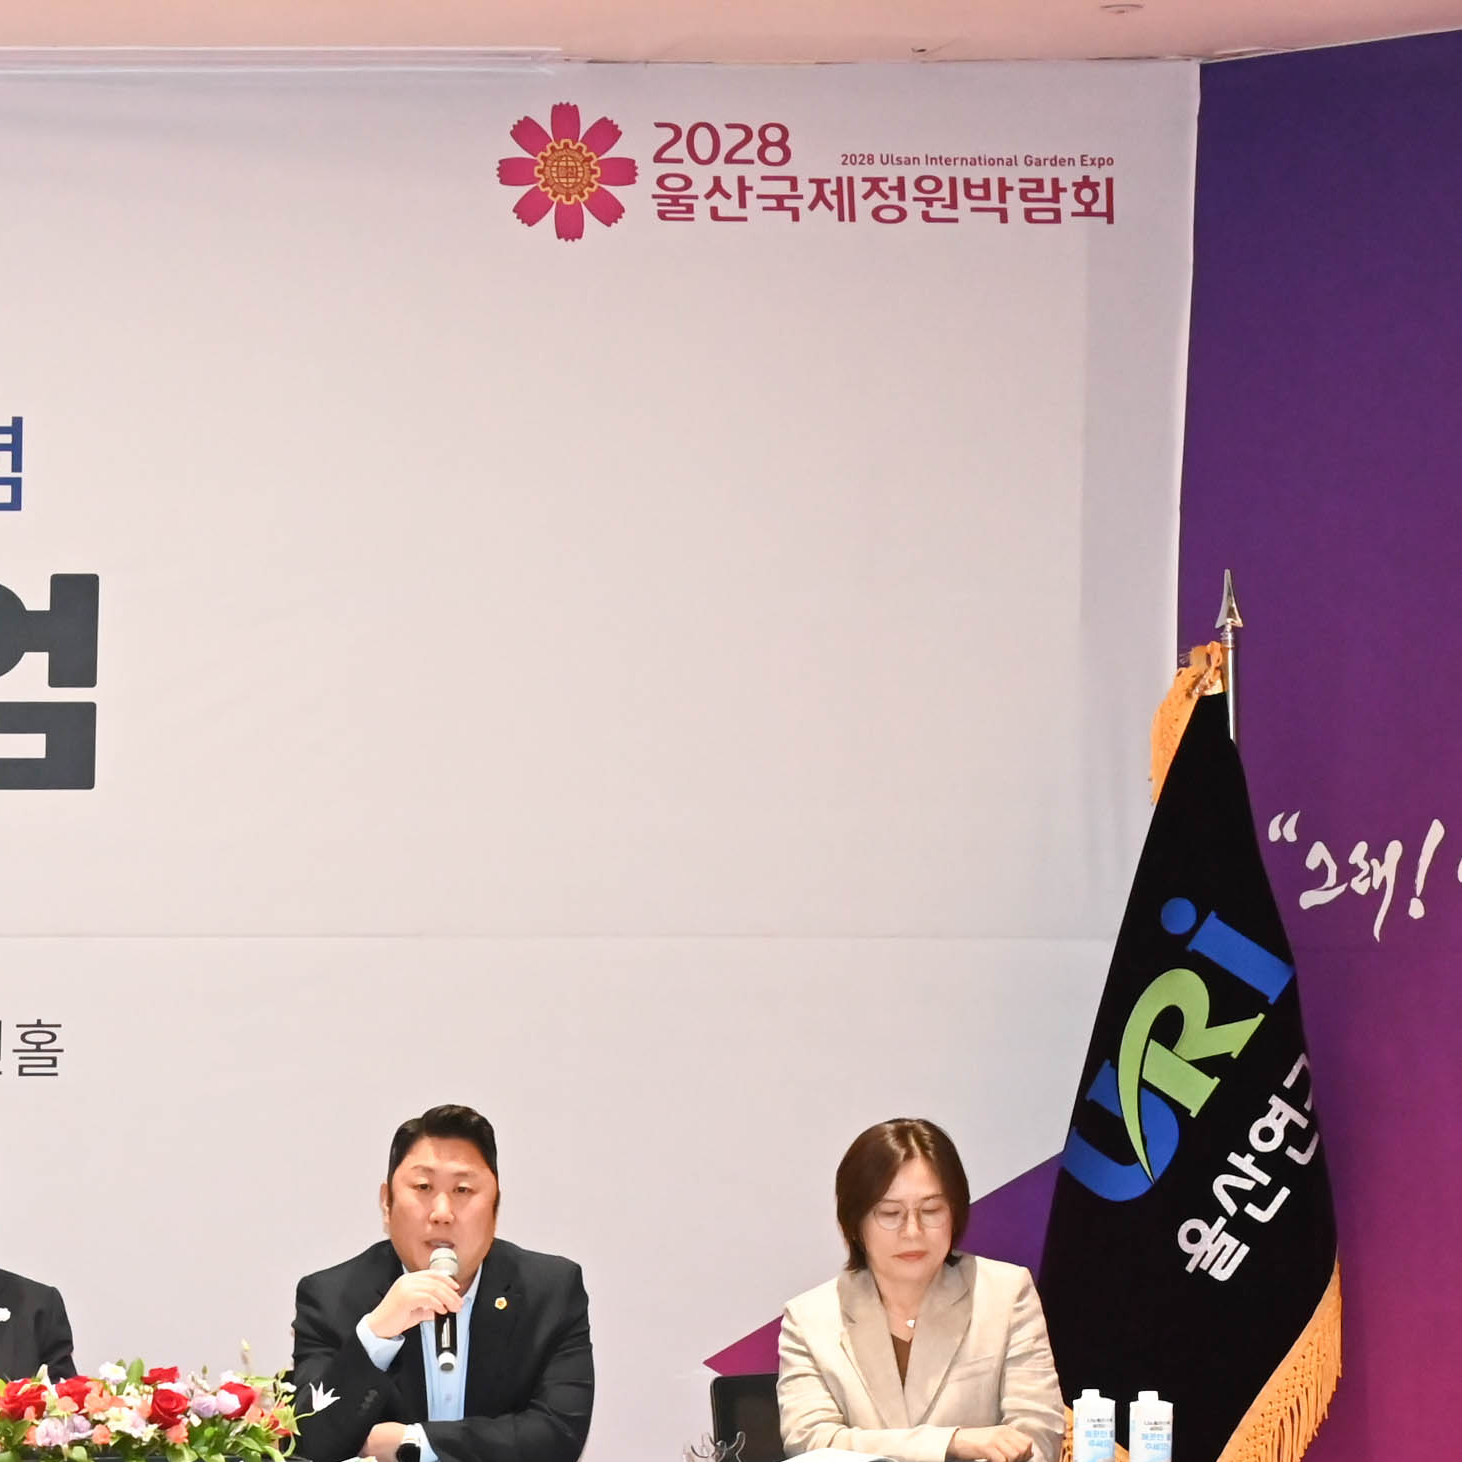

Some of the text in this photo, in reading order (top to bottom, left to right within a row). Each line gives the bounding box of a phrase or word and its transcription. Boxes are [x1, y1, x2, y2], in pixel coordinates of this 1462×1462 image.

[653, 122, 791, 166] 2028
[841, 153, 1114, 169] 2028 Ulsan International Garden Expo
[652, 173, 1114, 225] 울산국제정원박람회
